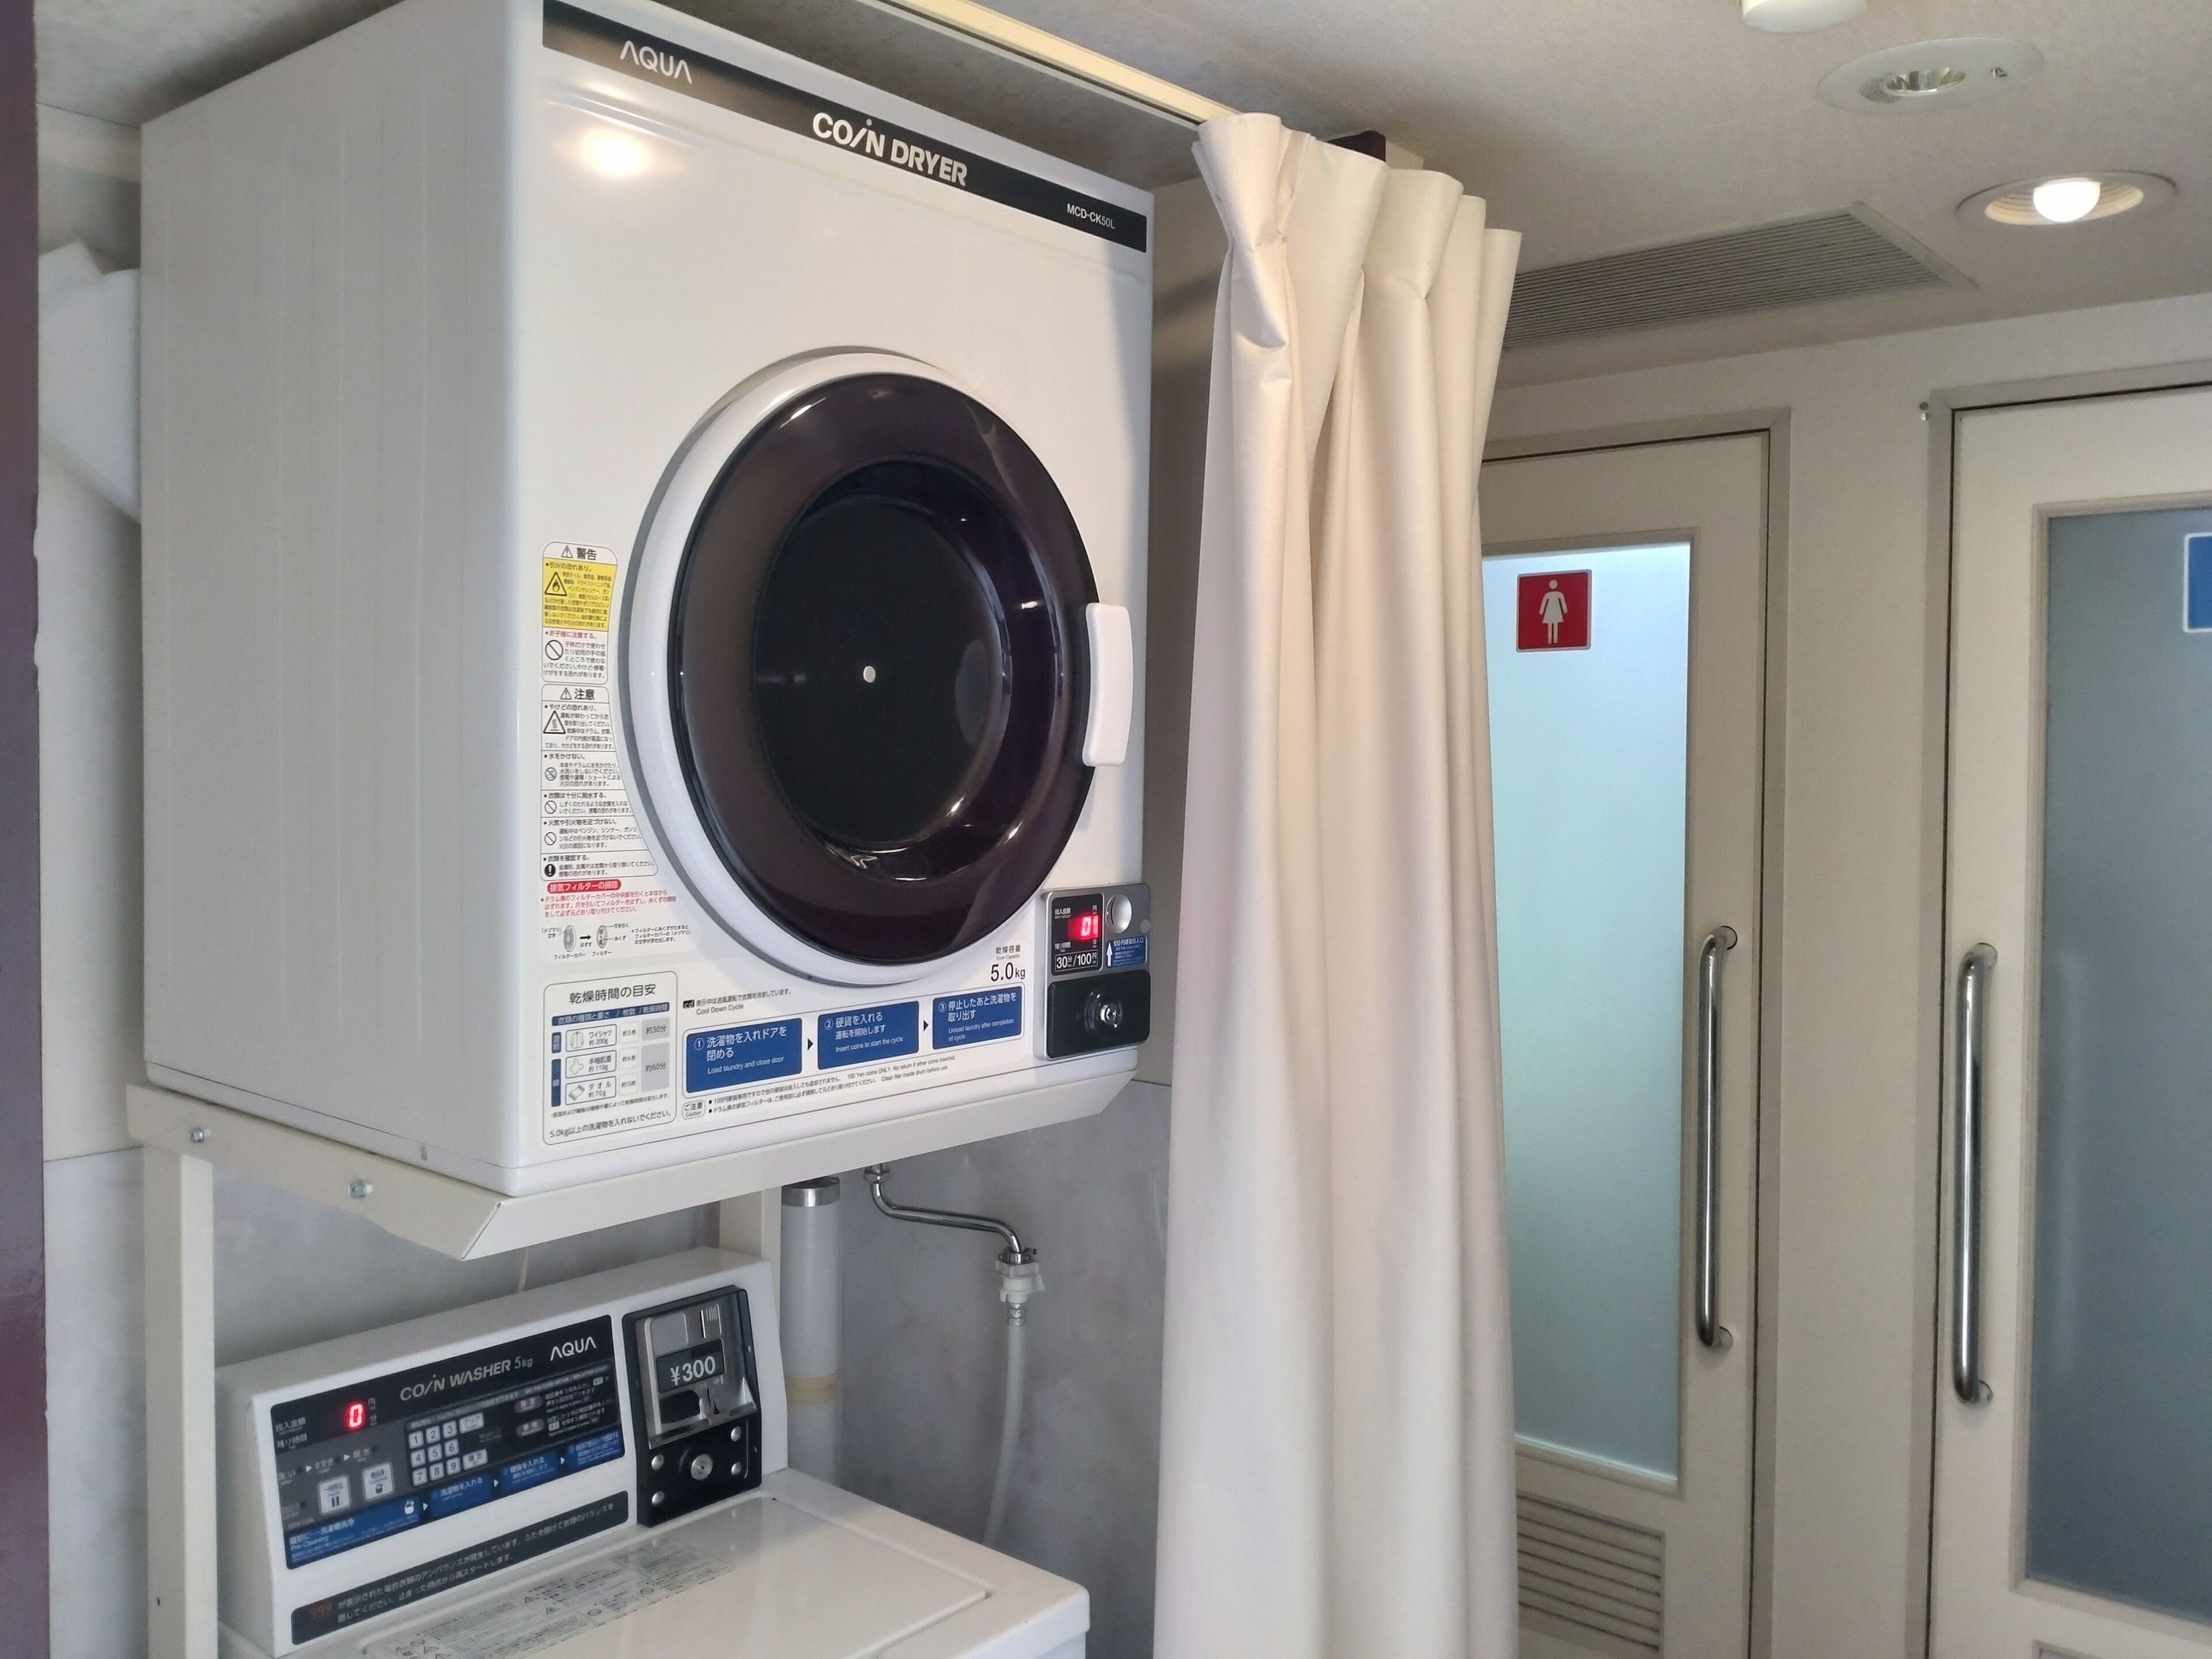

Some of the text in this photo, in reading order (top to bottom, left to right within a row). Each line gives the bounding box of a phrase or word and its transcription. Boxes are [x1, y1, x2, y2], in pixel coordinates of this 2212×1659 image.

[620, 40, 693, 84] AQUA
[891, 141, 968, 187] DRYER
[1066, 203, 1116, 230] MCD-CK50L
[577, 547, 597, 560] 警告
[574, 688, 595, 700] 注意
[550, 881, 619, 892] 排気フィルターの掃除
[569, 983, 657, 1005] 乾燥時間の目安
[948, 992, 1017, 1011] 停止したあと洗濯物を
[728, 1003, 744, 1012] Cycle
[948, 1009, 976, 1022] 取り出す
[835, 1012, 883, 1028] 硬貨を入れる
[991, 1018, 1014, 1027] completion
[589, 1030, 613, 1039] ワイシャツ
[646, 1025, 667, 1035] 約30分
[706, 1026, 787, 1048] 洗濯物を入れドアを
[835, 1024, 886, 1040] 運転を開始します
[835, 1044, 850, 1052] Insert
[891, 1036, 903, 1044] cycle
[706, 1047, 734, 1062] 閉める
[645, 1062, 666, 1072] 約60分
[707, 1066, 722, 1075] Load
[723, 1062, 743, 1072] laundry
[744, 1060, 755, 1068] and
[756, 1058, 771, 1066] close
[684, 1101, 703, 1112] ご注意
[550, 1336, 597, 1361] AQUA
[449, 1359, 512, 1387] WASHER
[514, 1356, 533, 1369] 5kg
[671, 1356, 715, 1385] ¥300
[349, 1404, 363, 1428] 0
